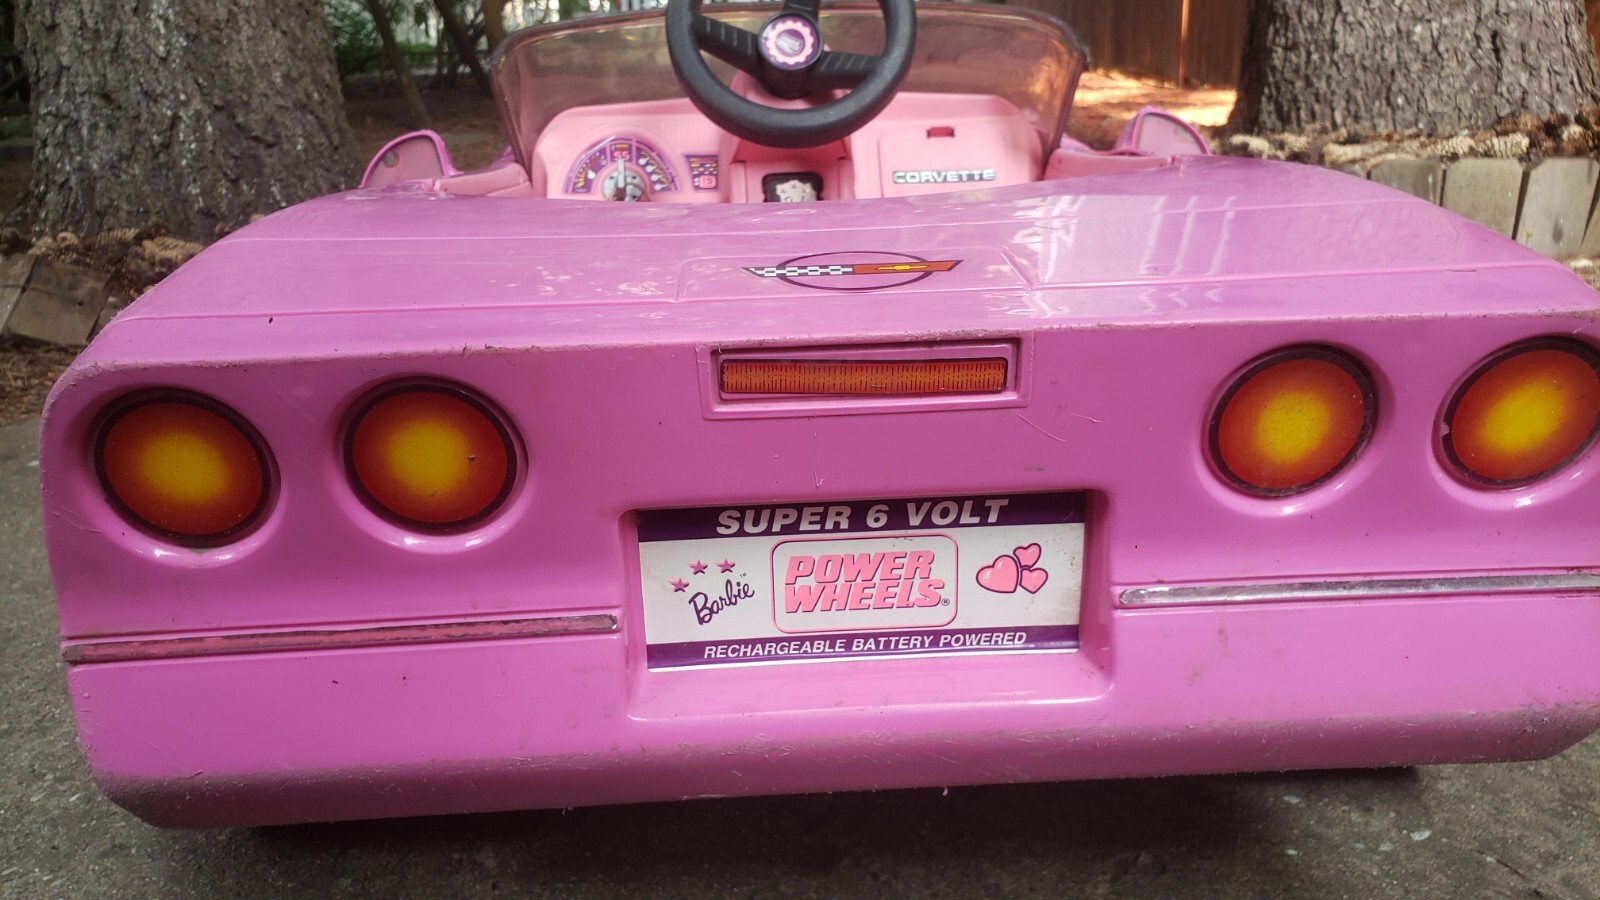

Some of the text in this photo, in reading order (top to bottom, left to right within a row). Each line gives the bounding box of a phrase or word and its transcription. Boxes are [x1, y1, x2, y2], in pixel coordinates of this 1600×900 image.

[893, 169, 996, 184] CORVETTE
[716, 499, 1009, 535] SUPER 6 VOLT
[785, 550, 935, 585] POWER
[688, 579, 755, 625] Barbie
[704, 632, 1027, 659] RECHARGEABLE BATTERY POWERED
